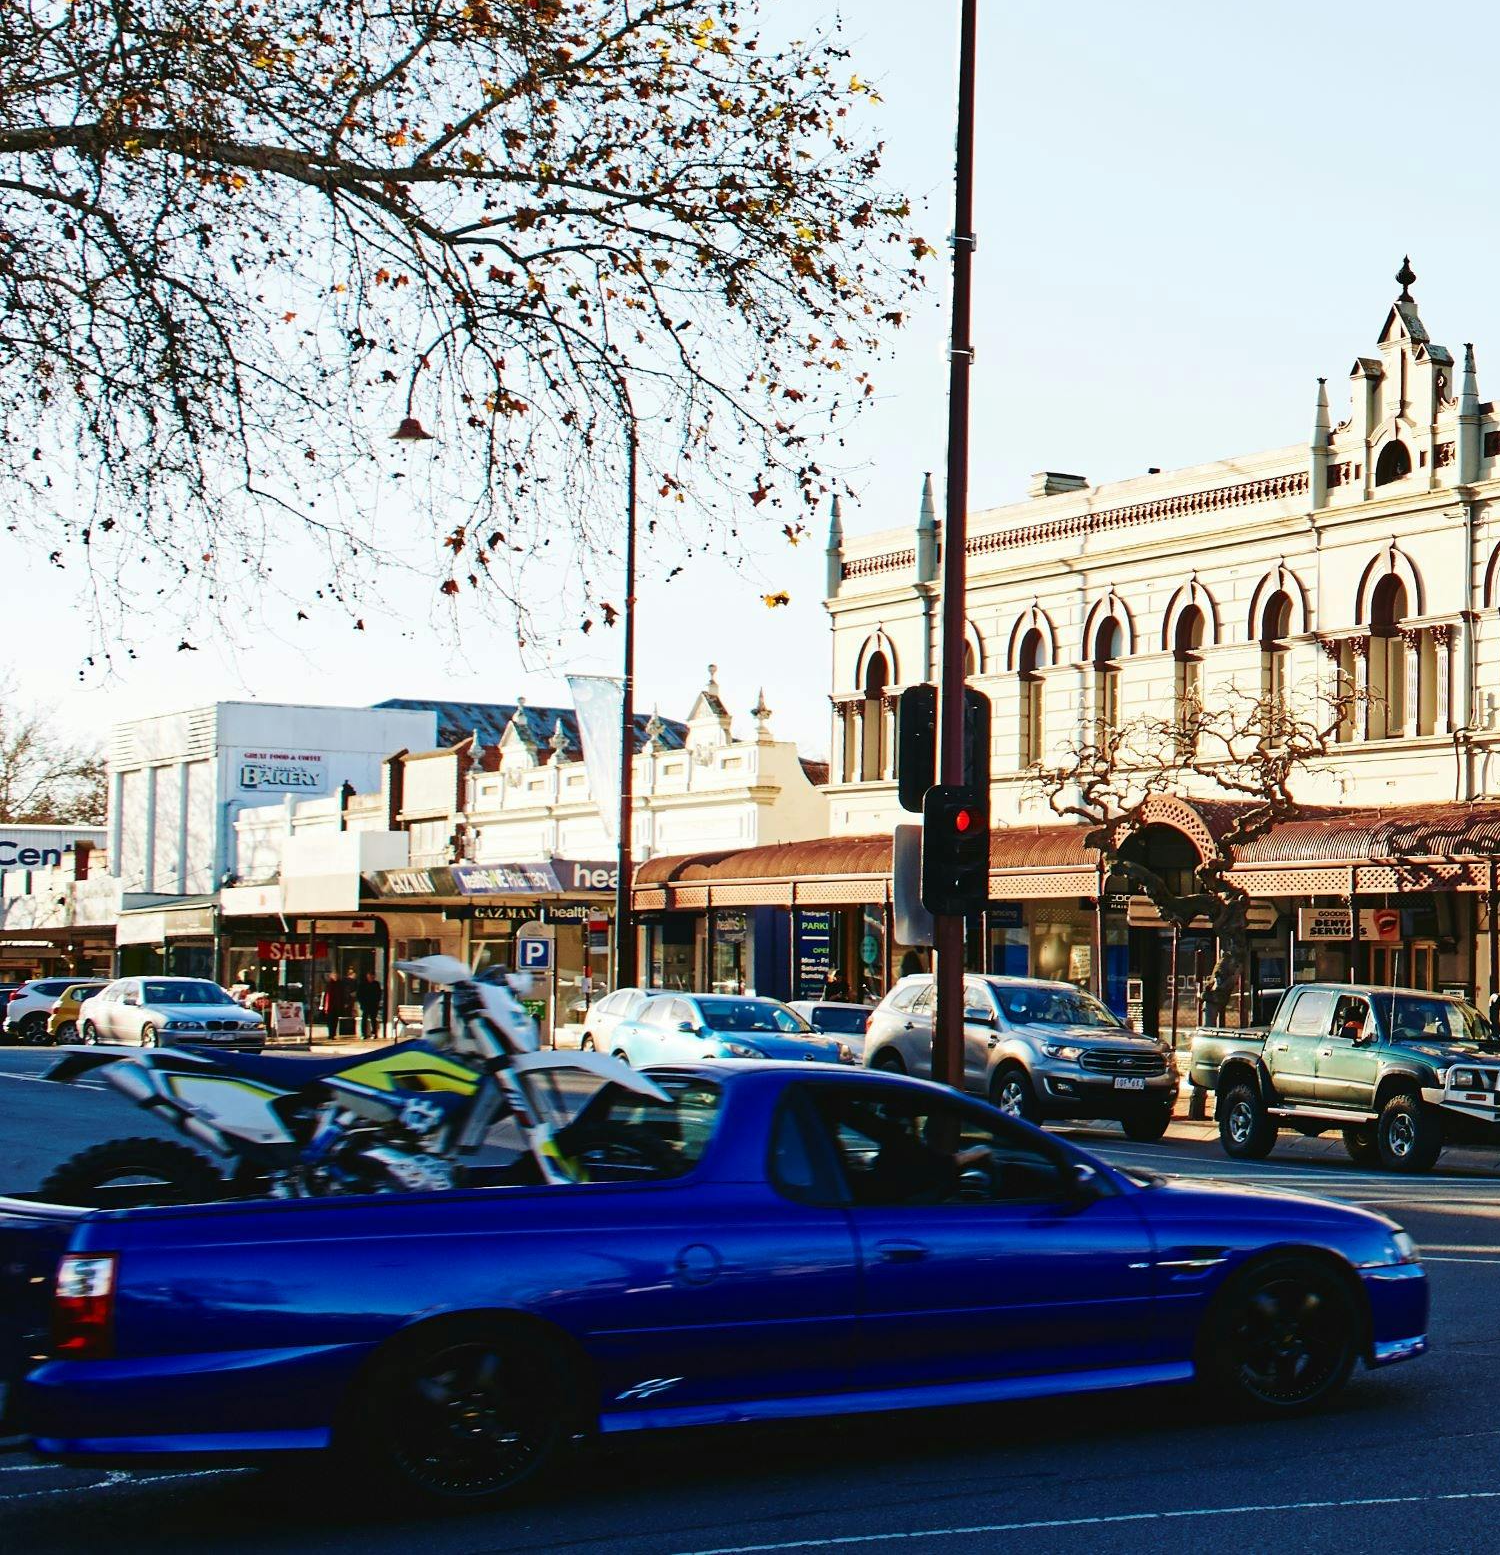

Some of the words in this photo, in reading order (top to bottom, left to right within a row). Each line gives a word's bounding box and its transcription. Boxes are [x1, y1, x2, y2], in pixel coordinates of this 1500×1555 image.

[240, 765, 320, 789] BAKERY
[573, 863, 617, 888] hea
[1309, 927, 1368, 936] SERVICS
[1314, 919, 1362, 927] DENTA
[526, 942, 544, 965] P
